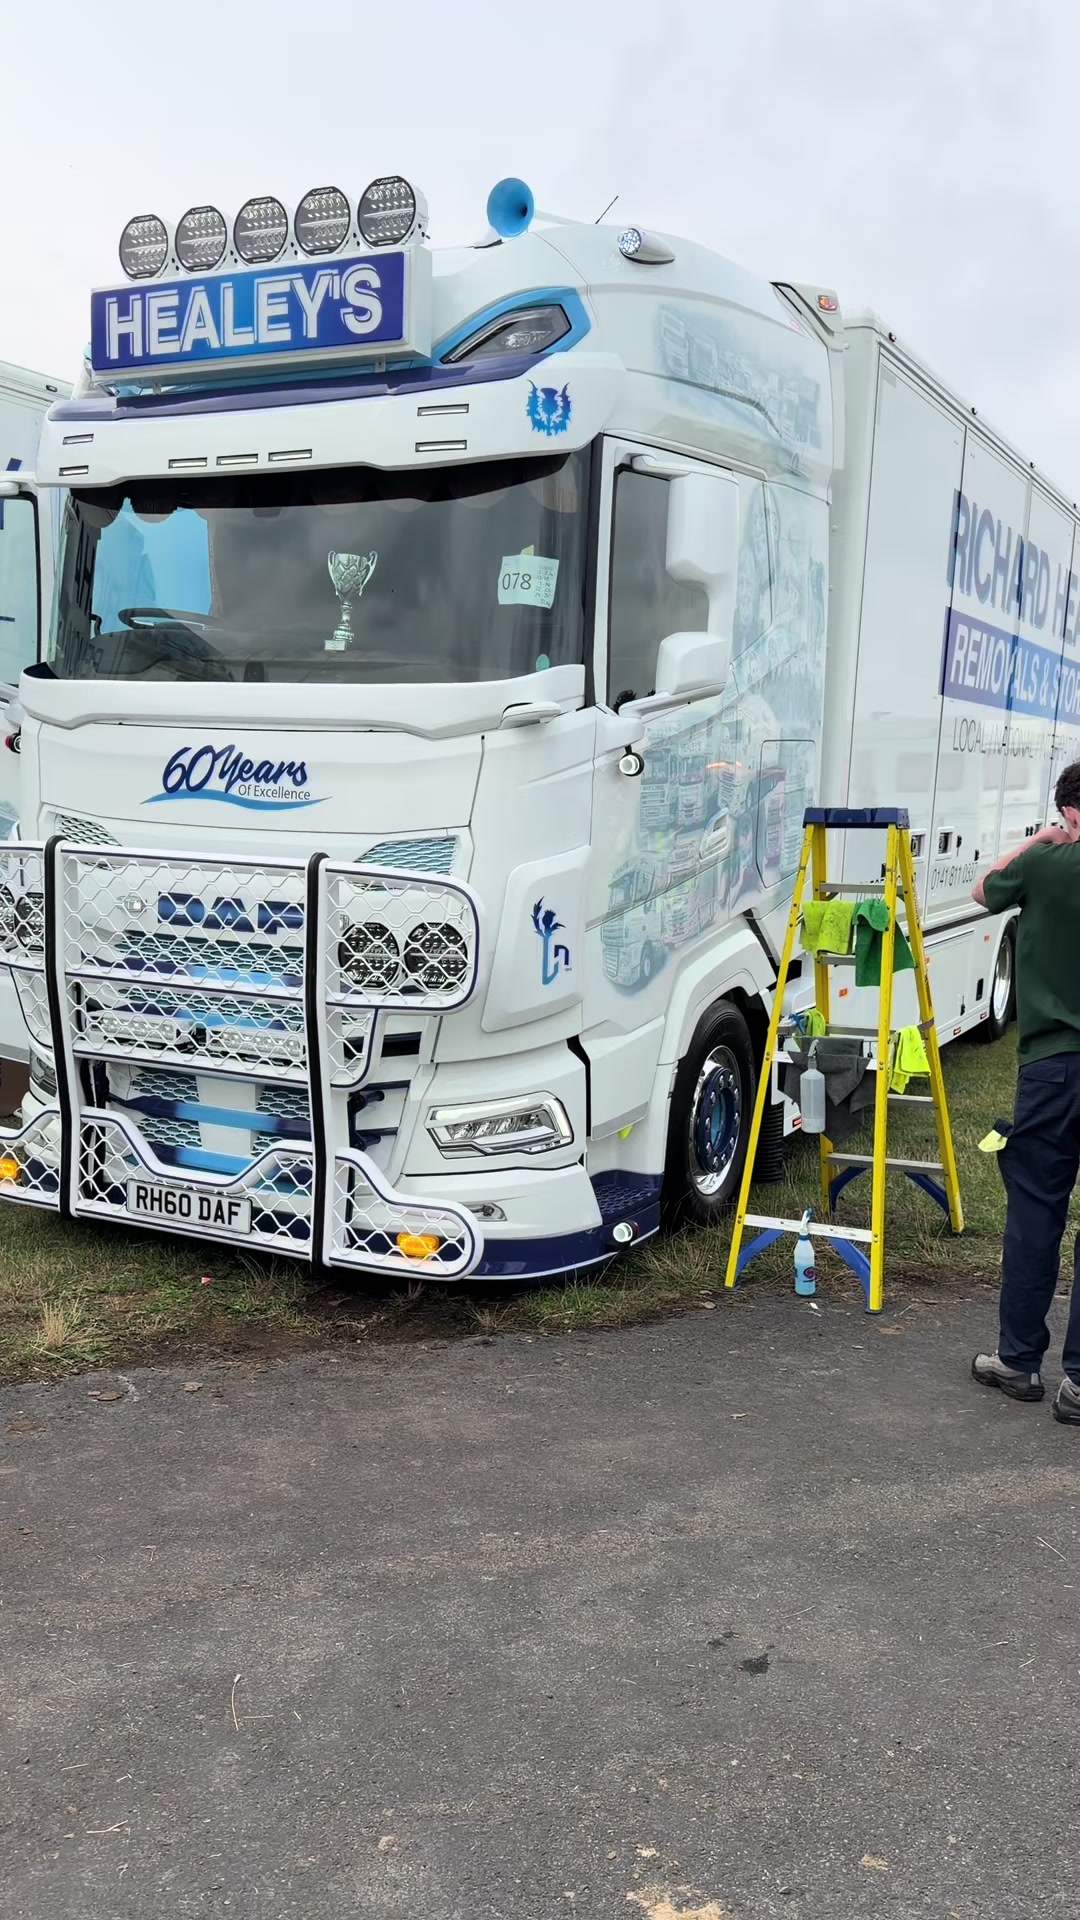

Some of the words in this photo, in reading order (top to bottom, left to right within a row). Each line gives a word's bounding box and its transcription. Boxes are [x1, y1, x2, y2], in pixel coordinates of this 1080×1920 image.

[105, 263, 383, 360] HEALEY'S
[946, 488, 1050, 630] RICHARD
[502, 572, 532, 590] 078
[950, 624, 1040, 703] REMOVALS
[1040, 657, 1050, 706] &
[953, 717, 986, 754] LOCAL
[162, 745, 217, 794] 60
[214, 744, 308, 793] Years
[238, 784, 252, 797] Of
[254, 785, 311, 800] Excellence
[931, 867, 949, 890] 0141
[157, 891, 304, 935] DAF
[136, 1185, 192, 1218] RH60
[198, 1196, 242, 1226] DAF
